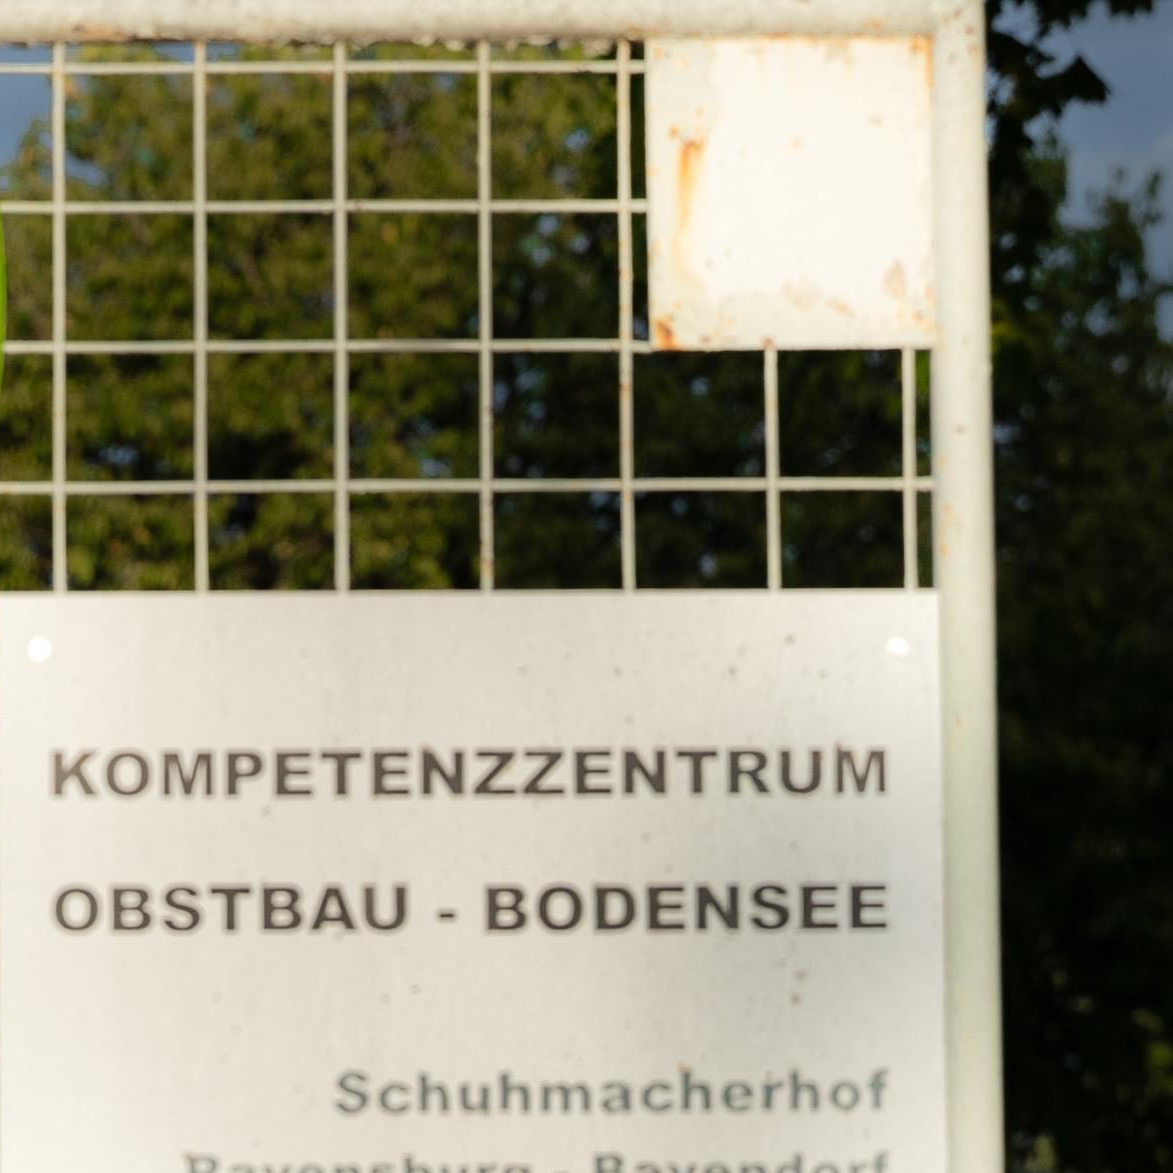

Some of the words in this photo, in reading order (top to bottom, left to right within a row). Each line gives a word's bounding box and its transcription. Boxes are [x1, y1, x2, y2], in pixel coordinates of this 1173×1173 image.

[51, 746, 888, 799] KOMPETENZZENTRUM
[53, 884, 410, 934] OBSTBAU
[483, 882, 889, 934] BODENSEE
[334, 1069, 891, 1115] Schuhmacherhof
